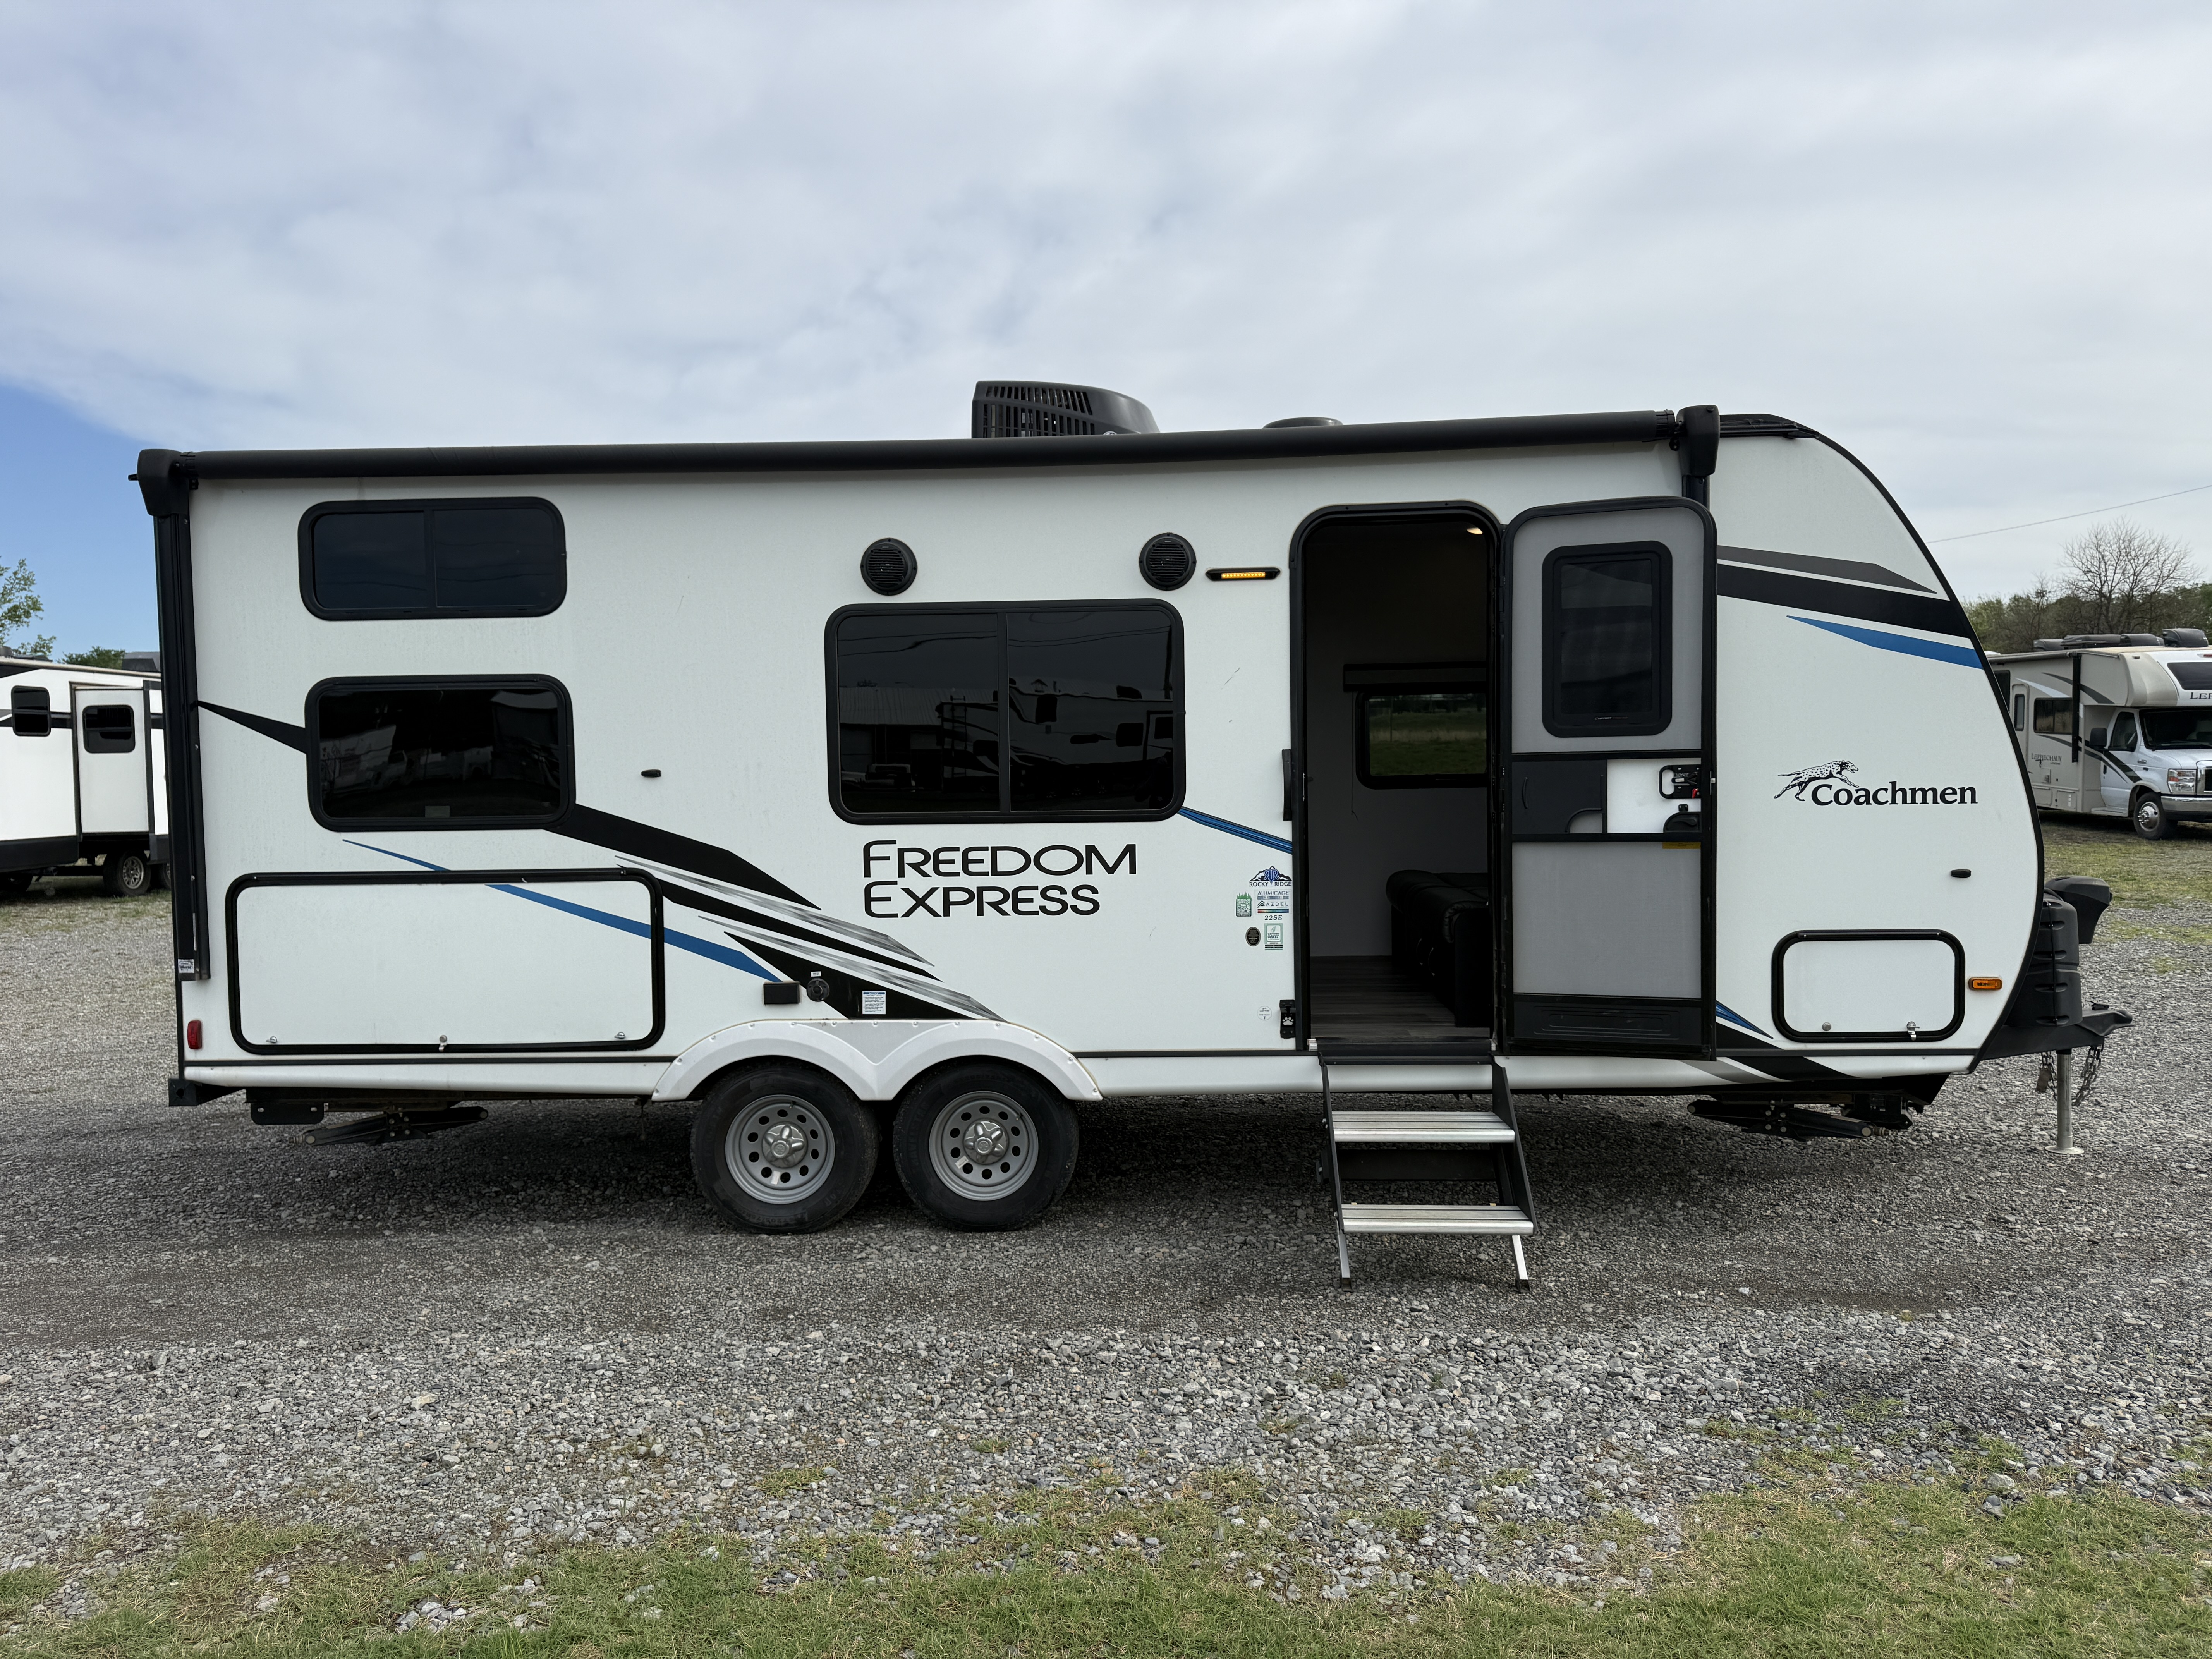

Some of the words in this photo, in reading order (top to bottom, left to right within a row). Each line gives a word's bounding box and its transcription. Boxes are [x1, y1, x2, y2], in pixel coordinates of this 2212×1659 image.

[1811, 780, 1978, 805] Coachmen
[863, 840, 1137, 878] FREEDOM
[864, 880, 1100, 918] EXPRESS
